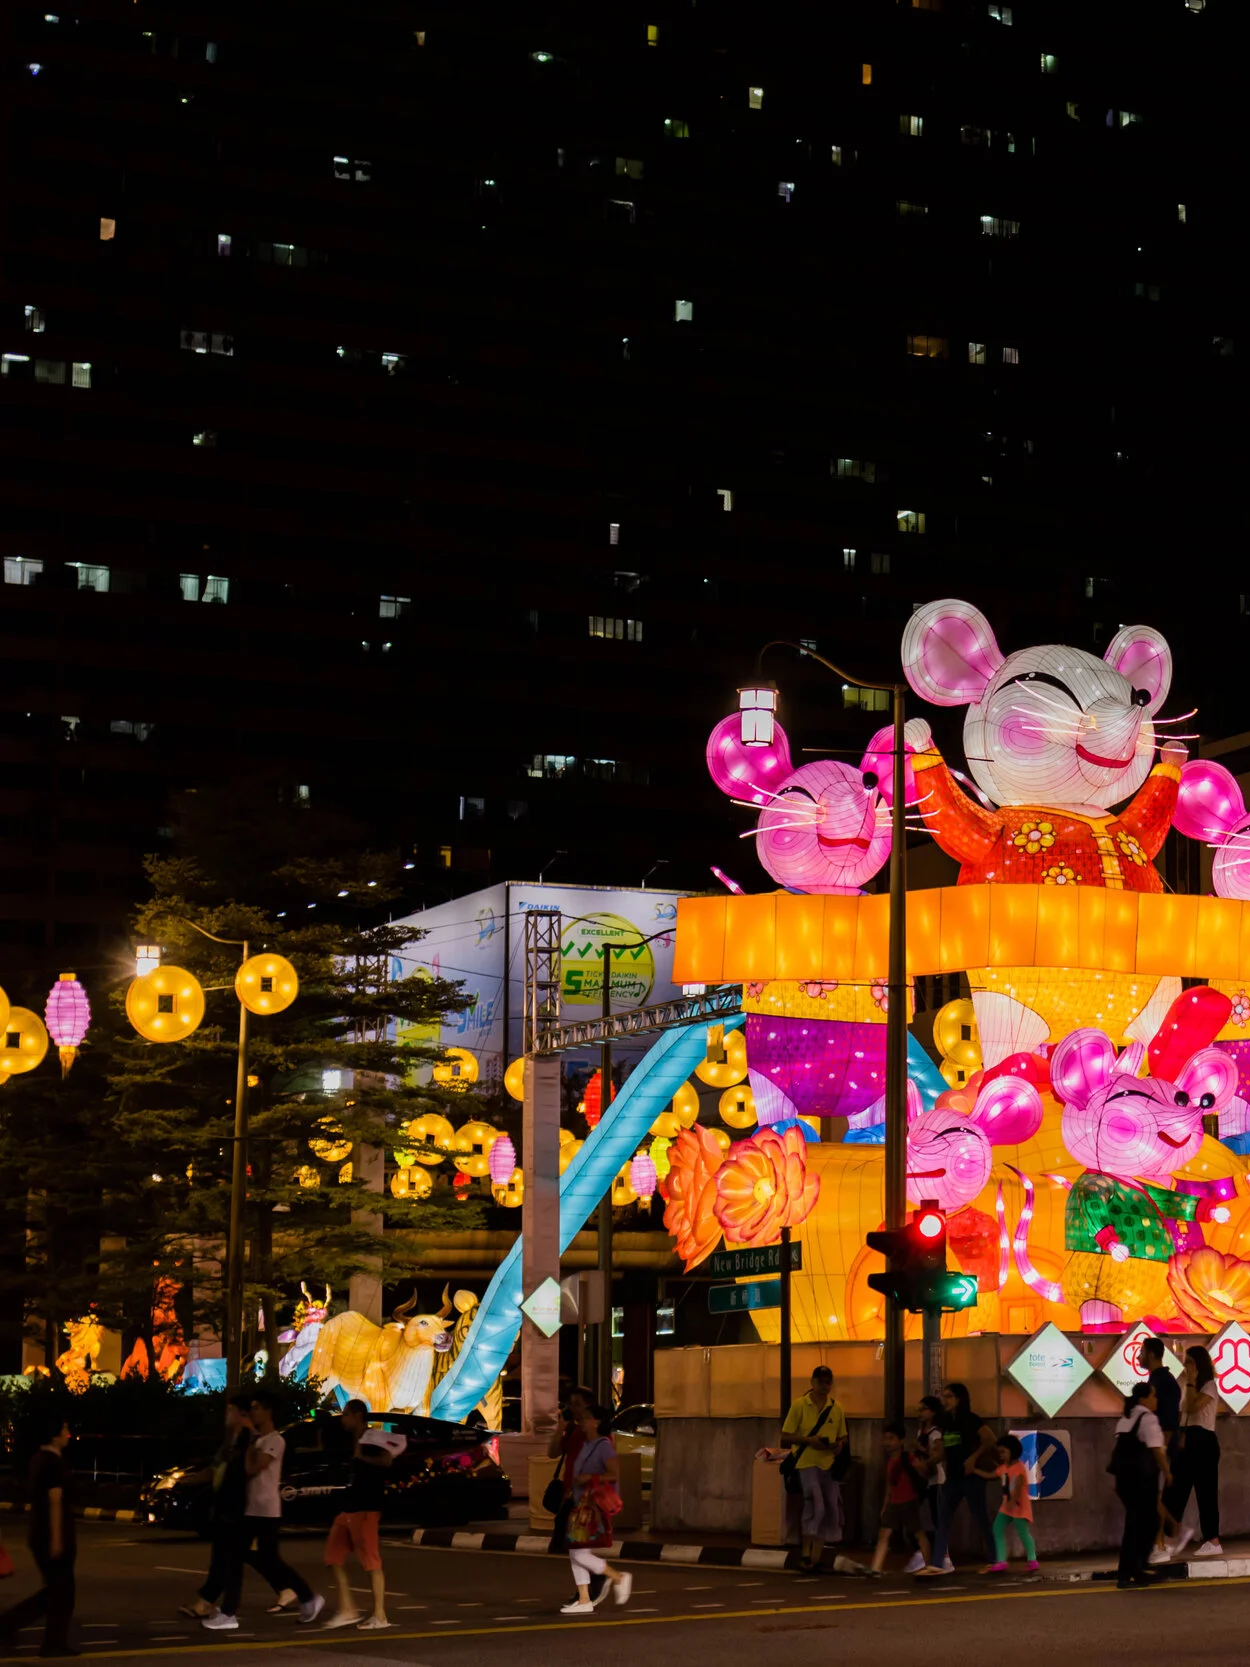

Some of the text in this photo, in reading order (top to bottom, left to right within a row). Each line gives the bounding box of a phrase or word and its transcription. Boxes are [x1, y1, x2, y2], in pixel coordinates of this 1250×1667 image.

[527, 903, 561, 911] DAIKIN
[581, 928, 624, 937] EXCELLENT
[564, 970, 584, 995] 5
[584, 979, 637, 989] MAMUM
[582, 990, 634, 998] EFFIENCY
[714, 1249, 780, 1273] New Bridge Rd
